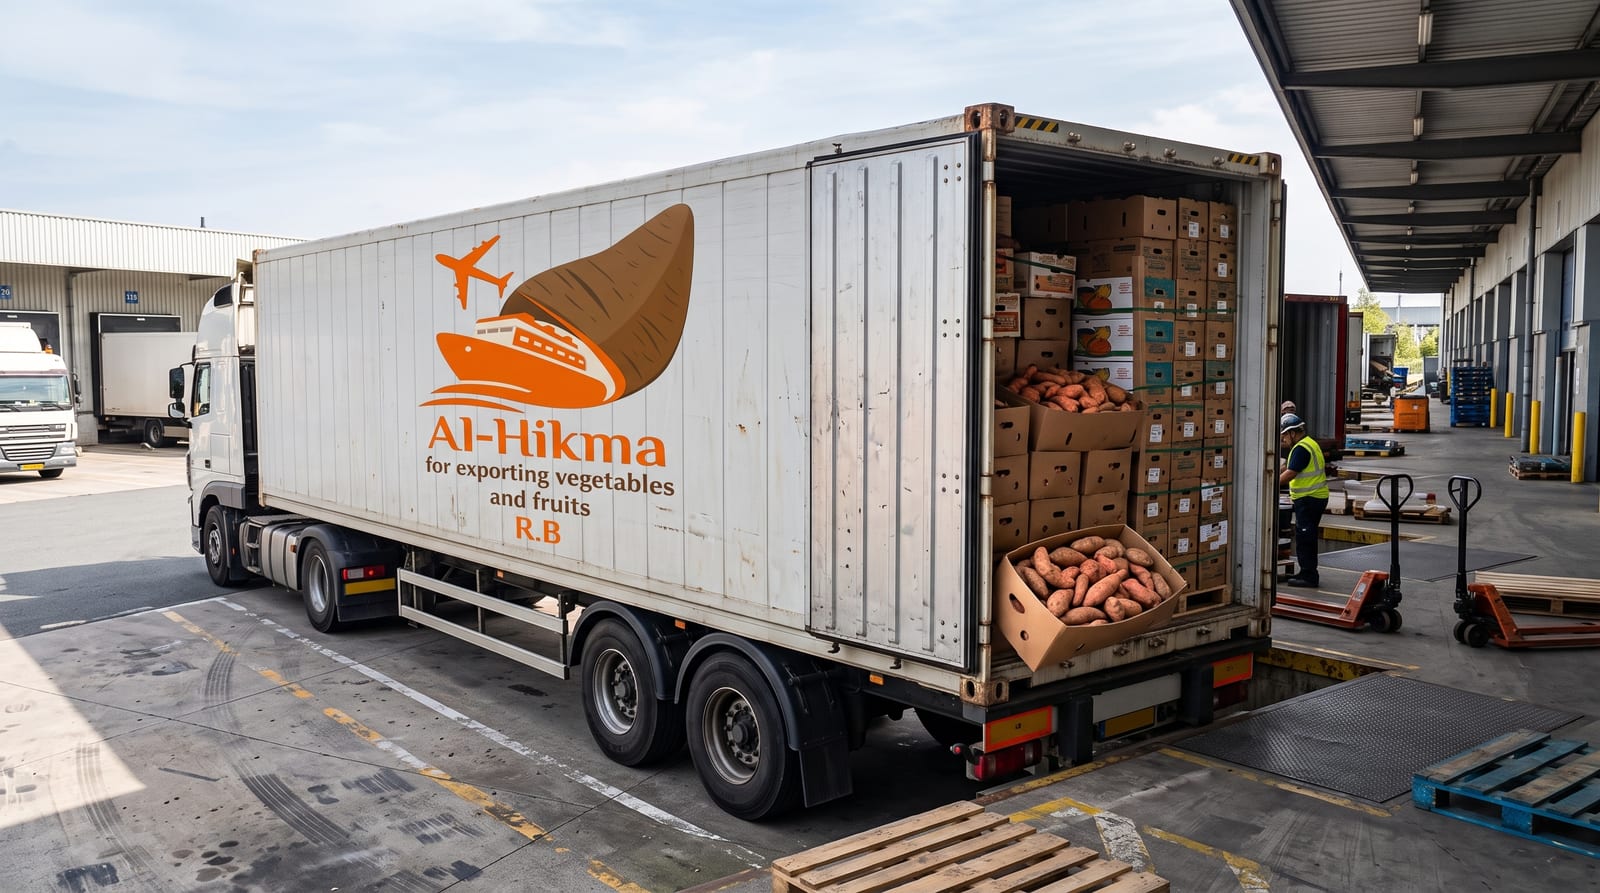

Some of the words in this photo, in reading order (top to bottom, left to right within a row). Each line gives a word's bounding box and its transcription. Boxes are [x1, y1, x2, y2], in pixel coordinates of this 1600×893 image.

[428, 415, 666, 467] Al-Hikma
[425, 456, 451, 474] for
[456, 463, 549, 489] exporting
[555, 471, 675, 496] vegetables
[490, 490, 526, 508] and
[533, 491, 591, 517] fruits
[515, 515, 561, 545] R.B
